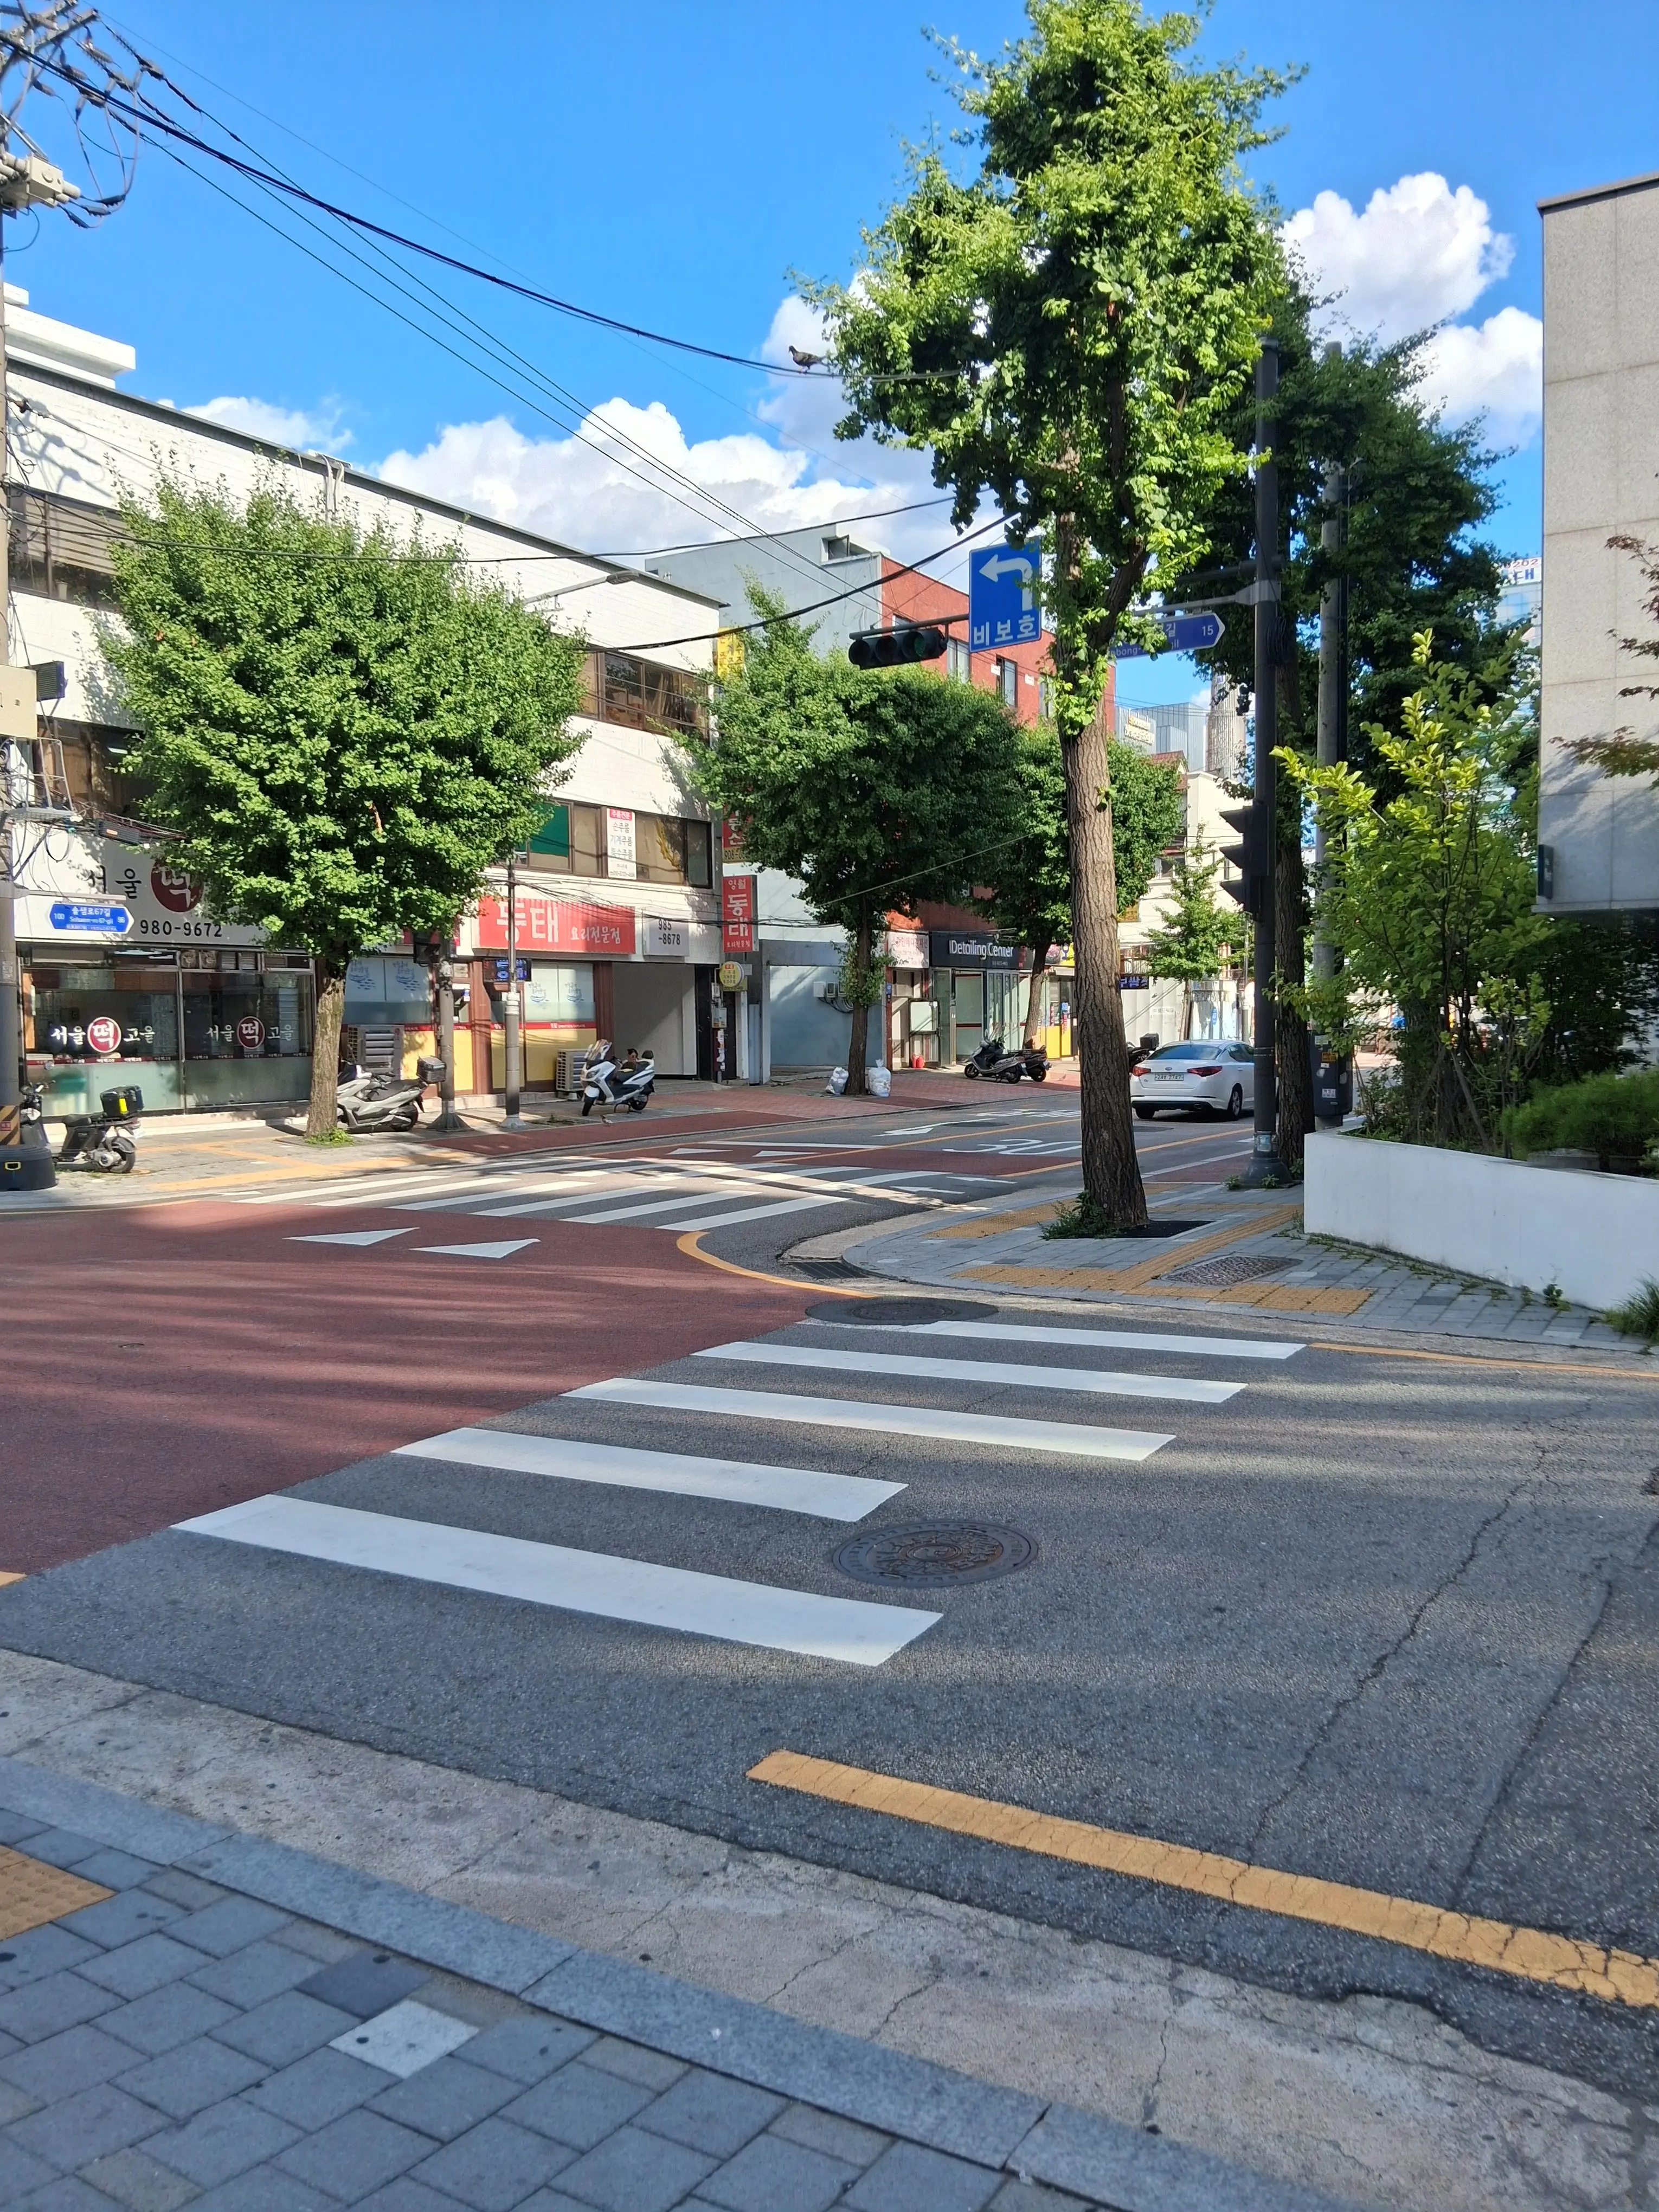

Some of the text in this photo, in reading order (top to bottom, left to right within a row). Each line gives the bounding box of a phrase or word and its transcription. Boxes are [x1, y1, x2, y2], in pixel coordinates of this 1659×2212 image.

[974, 615, 1036, 646] 비보호
[1201, 625, 1214, 636] 15
[728, 878, 746, 890] 영월
[72, 906, 111, 917] 솔샘로67길
[727, 893, 748, 937] 동태
[140, 919, 223, 937] 980-9672
[496, 902, 621, 944] 동태 요리전문점
[658, 919, 672, 931] 985
[658, 934, 681, 946] -8678
[949, 940, 987, 960] Detailing
[987, 942, 1014, 957] Center
[50, 1021, 156, 1049] 서울 떡 고을
[206, 1020, 294, 1045] 서울 떡 고을
[942, 1139, 1082, 1155] 30
